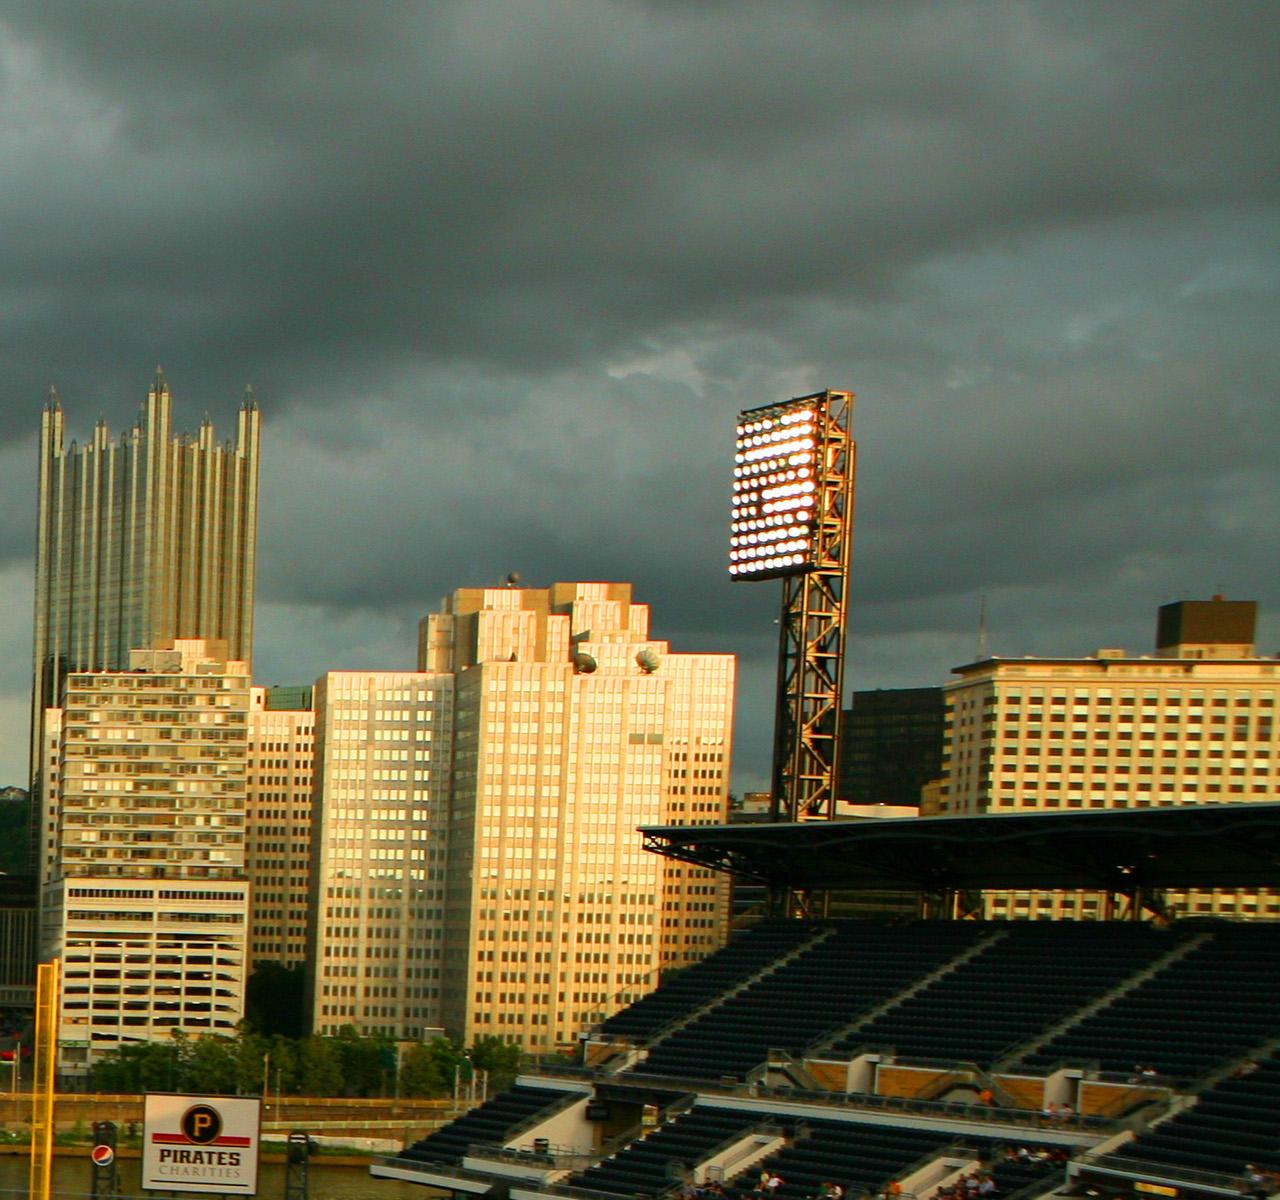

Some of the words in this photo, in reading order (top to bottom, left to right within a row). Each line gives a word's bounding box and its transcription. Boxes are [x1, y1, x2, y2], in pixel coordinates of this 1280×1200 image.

[194, 1112, 212, 1137] P
[159, 1148, 241, 1167] PIRATES
[158, 1164, 241, 1179] CHARITIES
